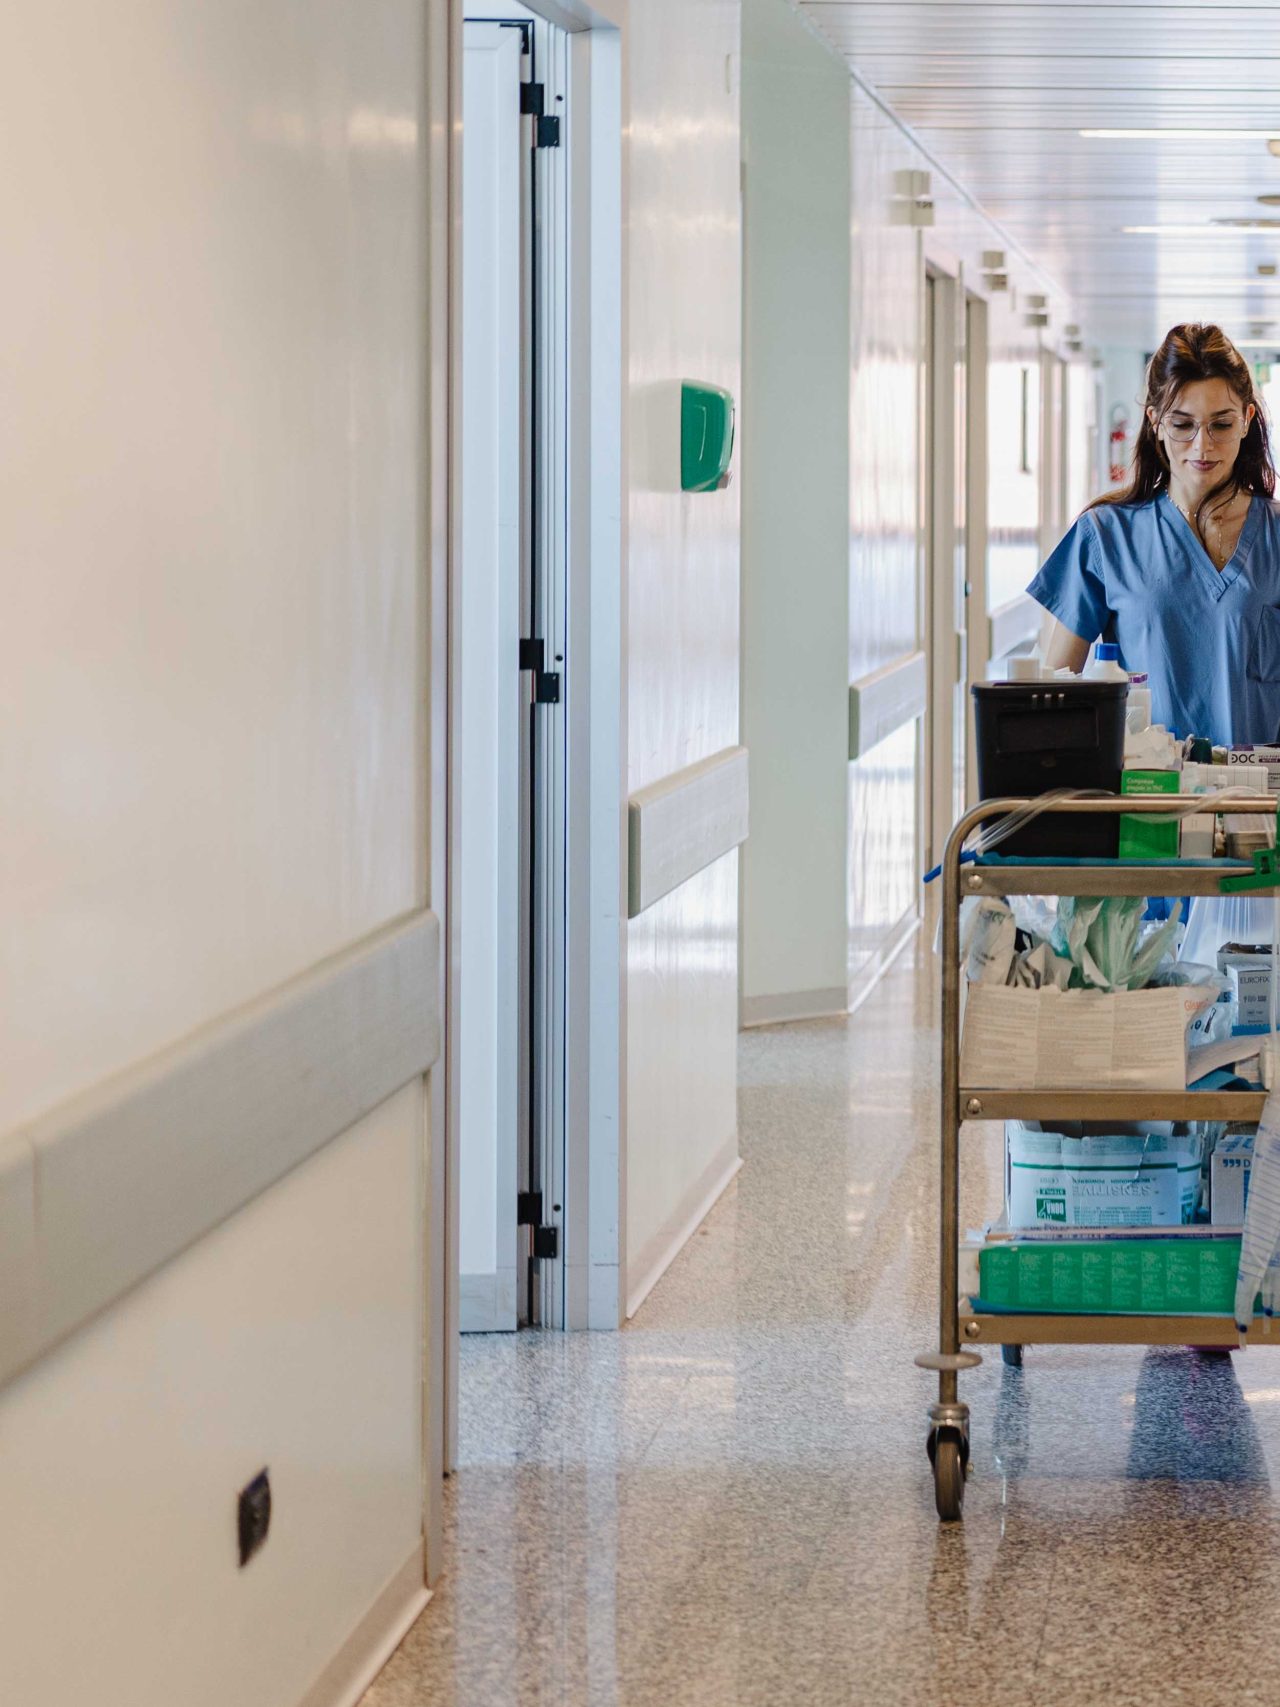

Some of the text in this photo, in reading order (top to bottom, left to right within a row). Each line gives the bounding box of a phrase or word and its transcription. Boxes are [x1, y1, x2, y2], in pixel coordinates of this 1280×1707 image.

[1231, 754, 1255, 763] DOC
[1240, 975, 1270, 984] EUROFIX
[1072, 1185, 1151, 1197] SENSITIVE
